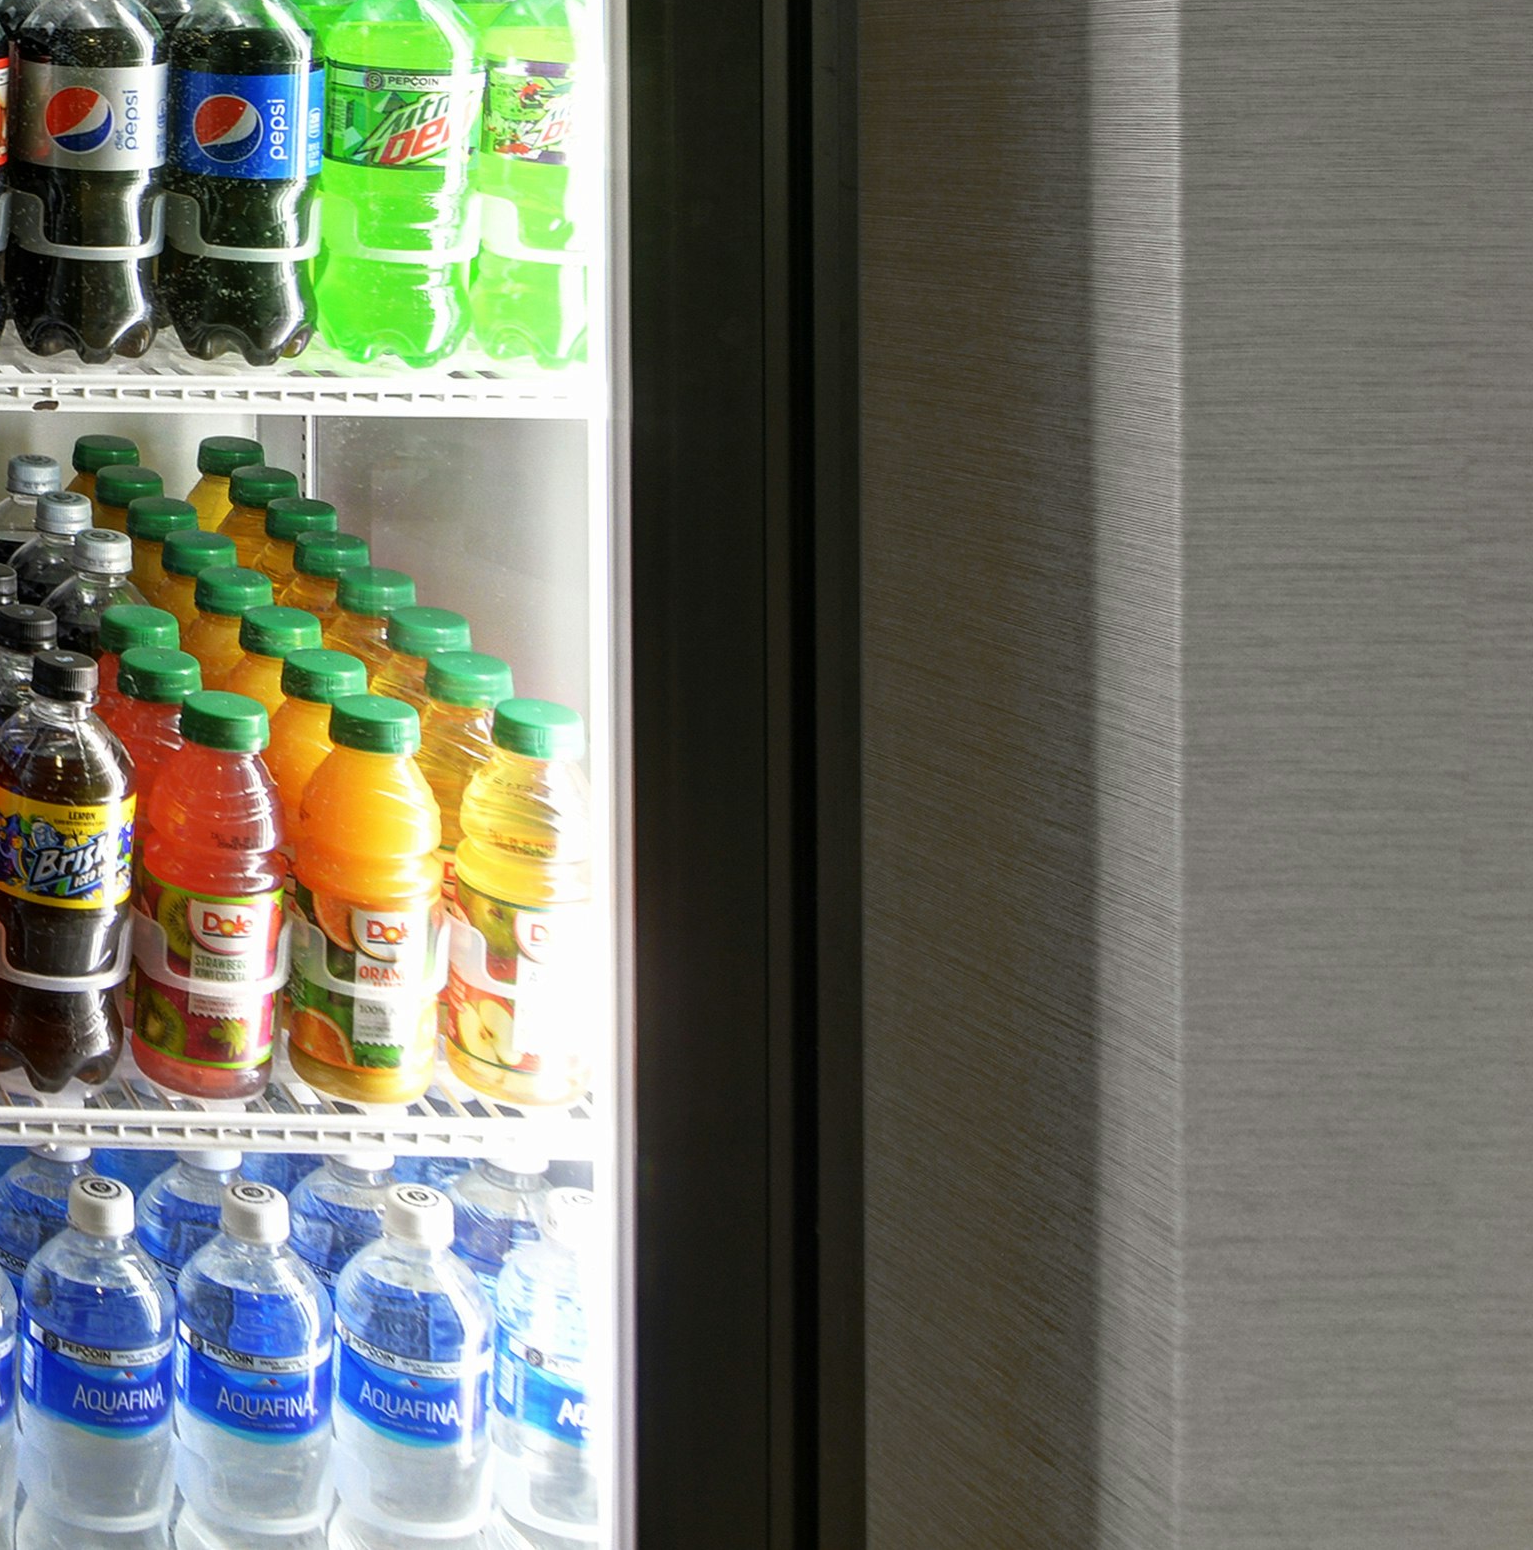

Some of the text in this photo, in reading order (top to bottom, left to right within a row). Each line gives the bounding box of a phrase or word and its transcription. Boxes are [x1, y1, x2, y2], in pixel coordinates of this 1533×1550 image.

[388, 76, 439, 87] PEPCOIN
[123, 90, 141, 151] pepsi
[269, 98, 290, 160] pepsi
[115, 130, 124, 151] diet
[68, 811, 96, 821] LEMON
[202, 910, 254, 937] Dole
[194, 968, 213, 980] KIWI
[61, 1339, 112, 1363] PEPCOIN
[72, 1381, 165, 1413] AQUAFINA
[217, 1389, 316, 1420] AQUAFINA
[358, 1380, 462, 1424] AQUAFINA
